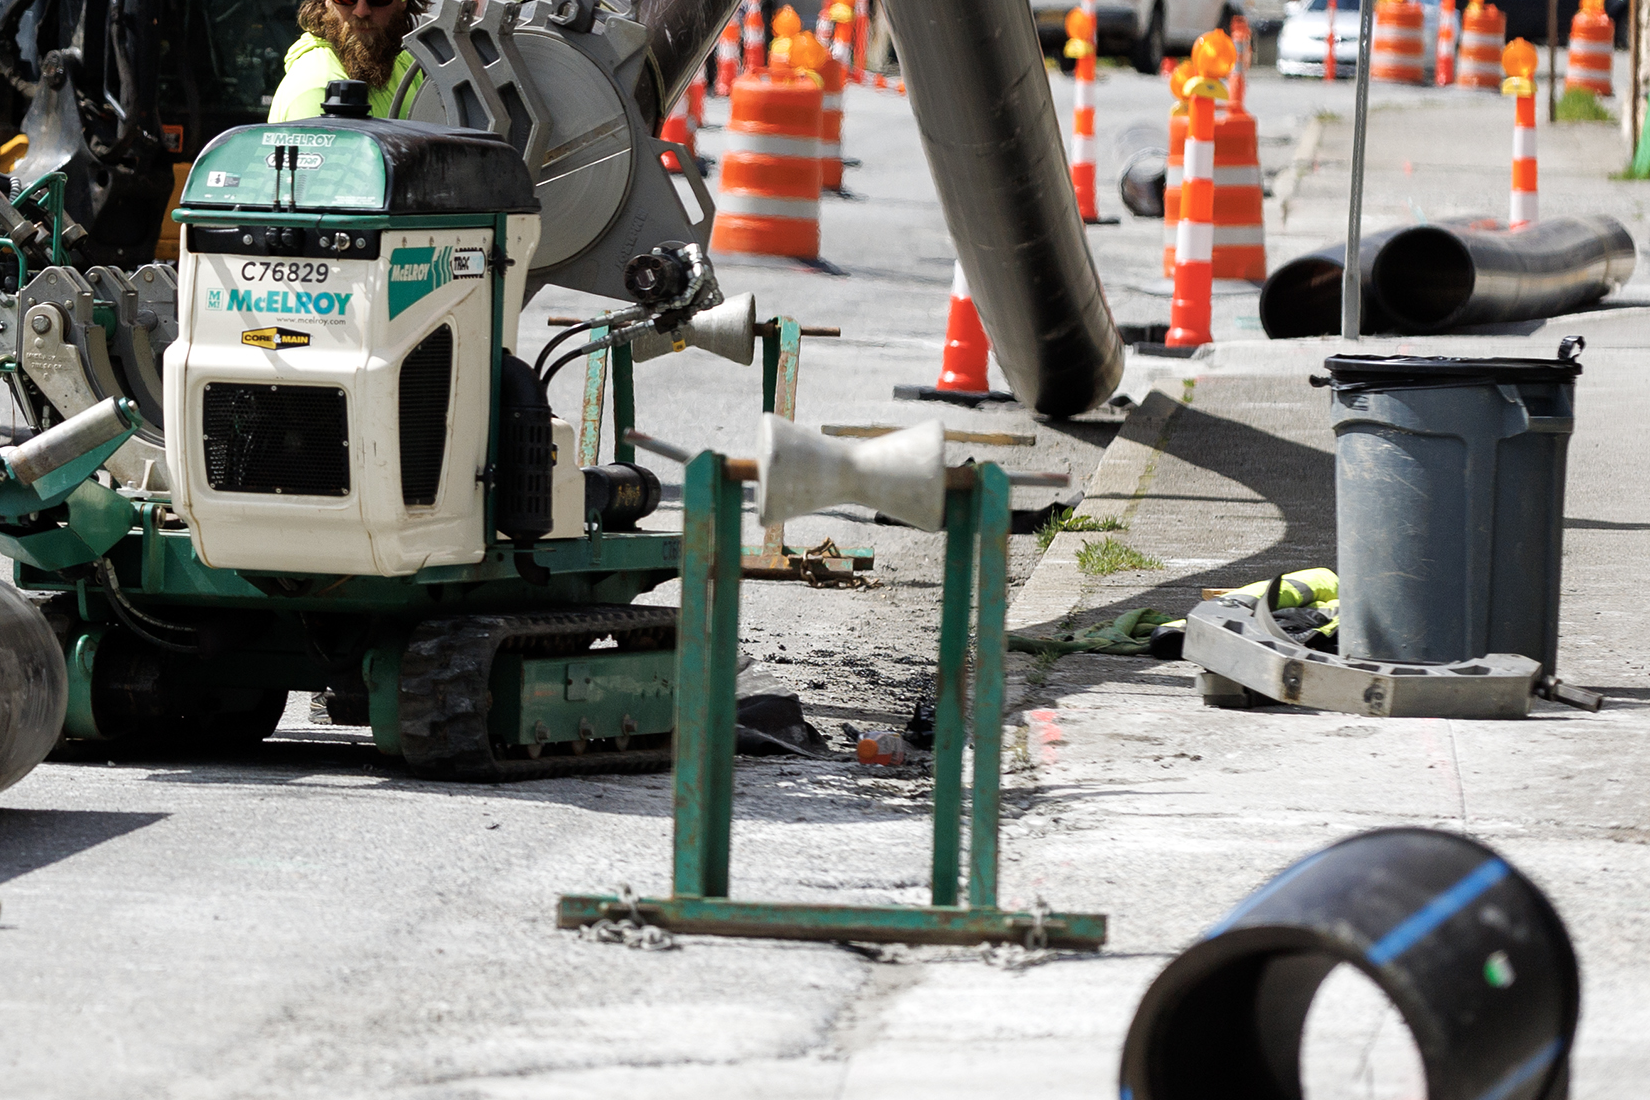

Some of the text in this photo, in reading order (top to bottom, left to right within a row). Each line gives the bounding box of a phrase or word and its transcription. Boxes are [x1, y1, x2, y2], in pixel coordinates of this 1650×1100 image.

[274, 132, 336, 147] McELROY
[241, 261, 329, 284] C76829
[391, 263, 430, 281] McELROY
[226, 288, 353, 316] McELROY
[276, 316, 347, 326] www.mcelroy.com
